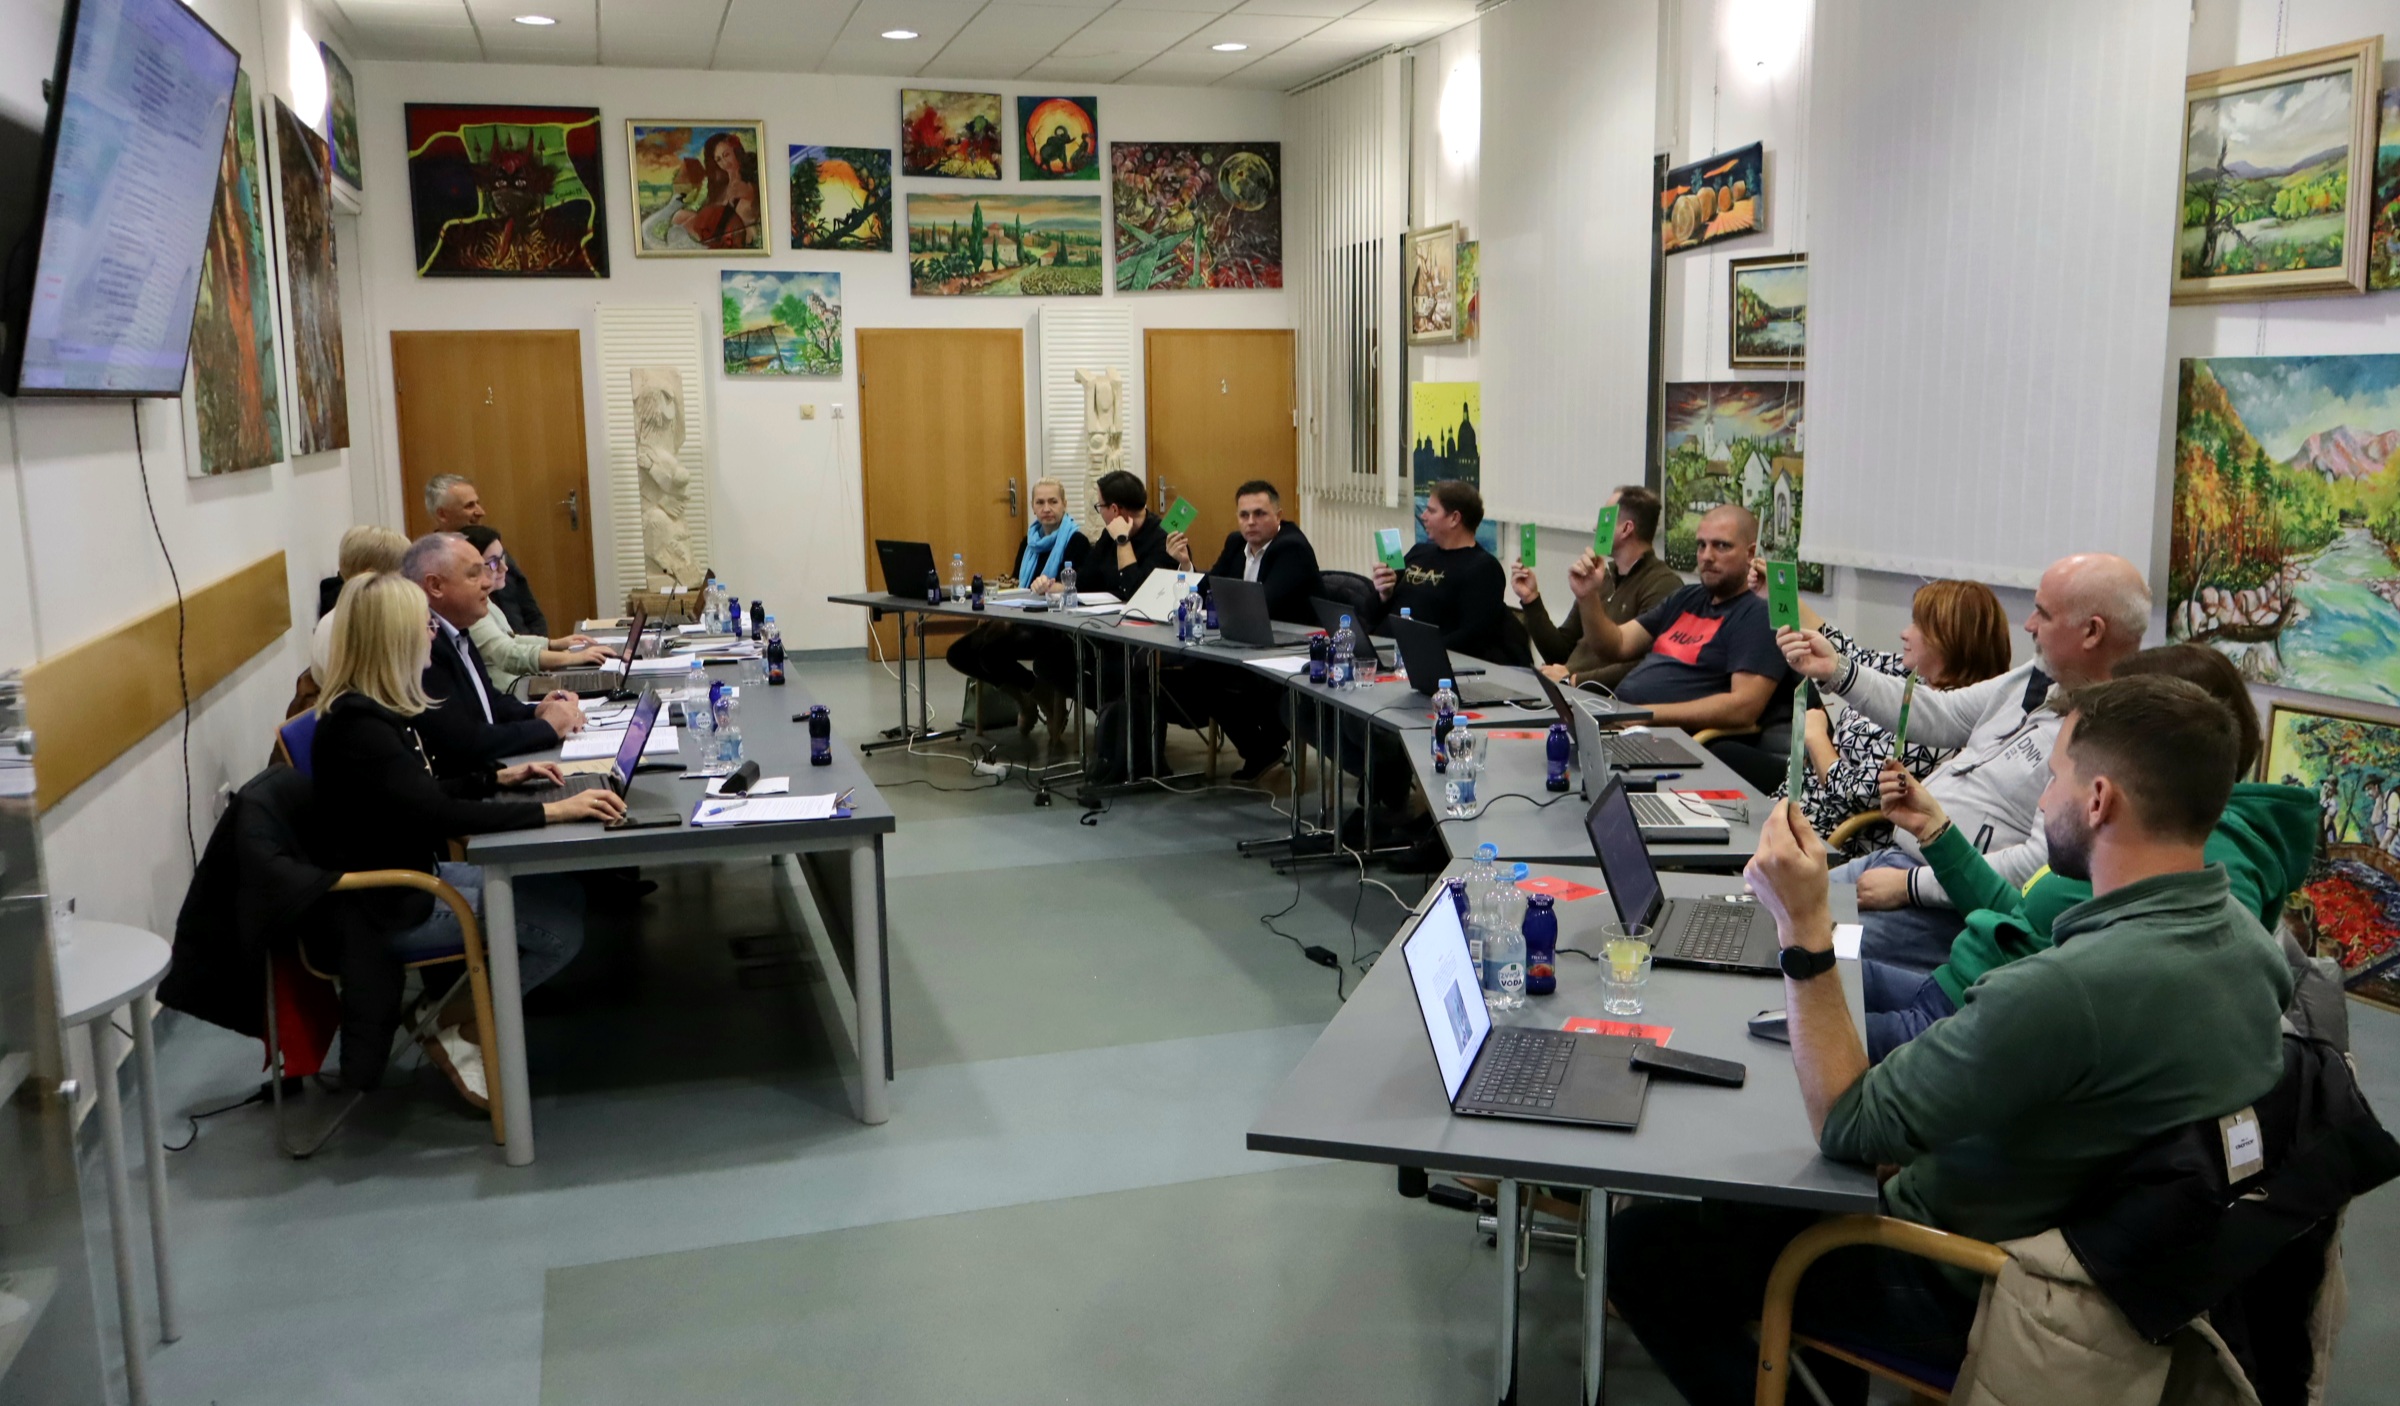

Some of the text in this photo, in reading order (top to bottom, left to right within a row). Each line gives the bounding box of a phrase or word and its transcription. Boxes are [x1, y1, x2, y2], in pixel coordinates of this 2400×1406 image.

[1779, 603, 1789, 613] ZA
[2017, 736, 2044, 768] DNM
[1501, 979, 1522, 987] VODA
